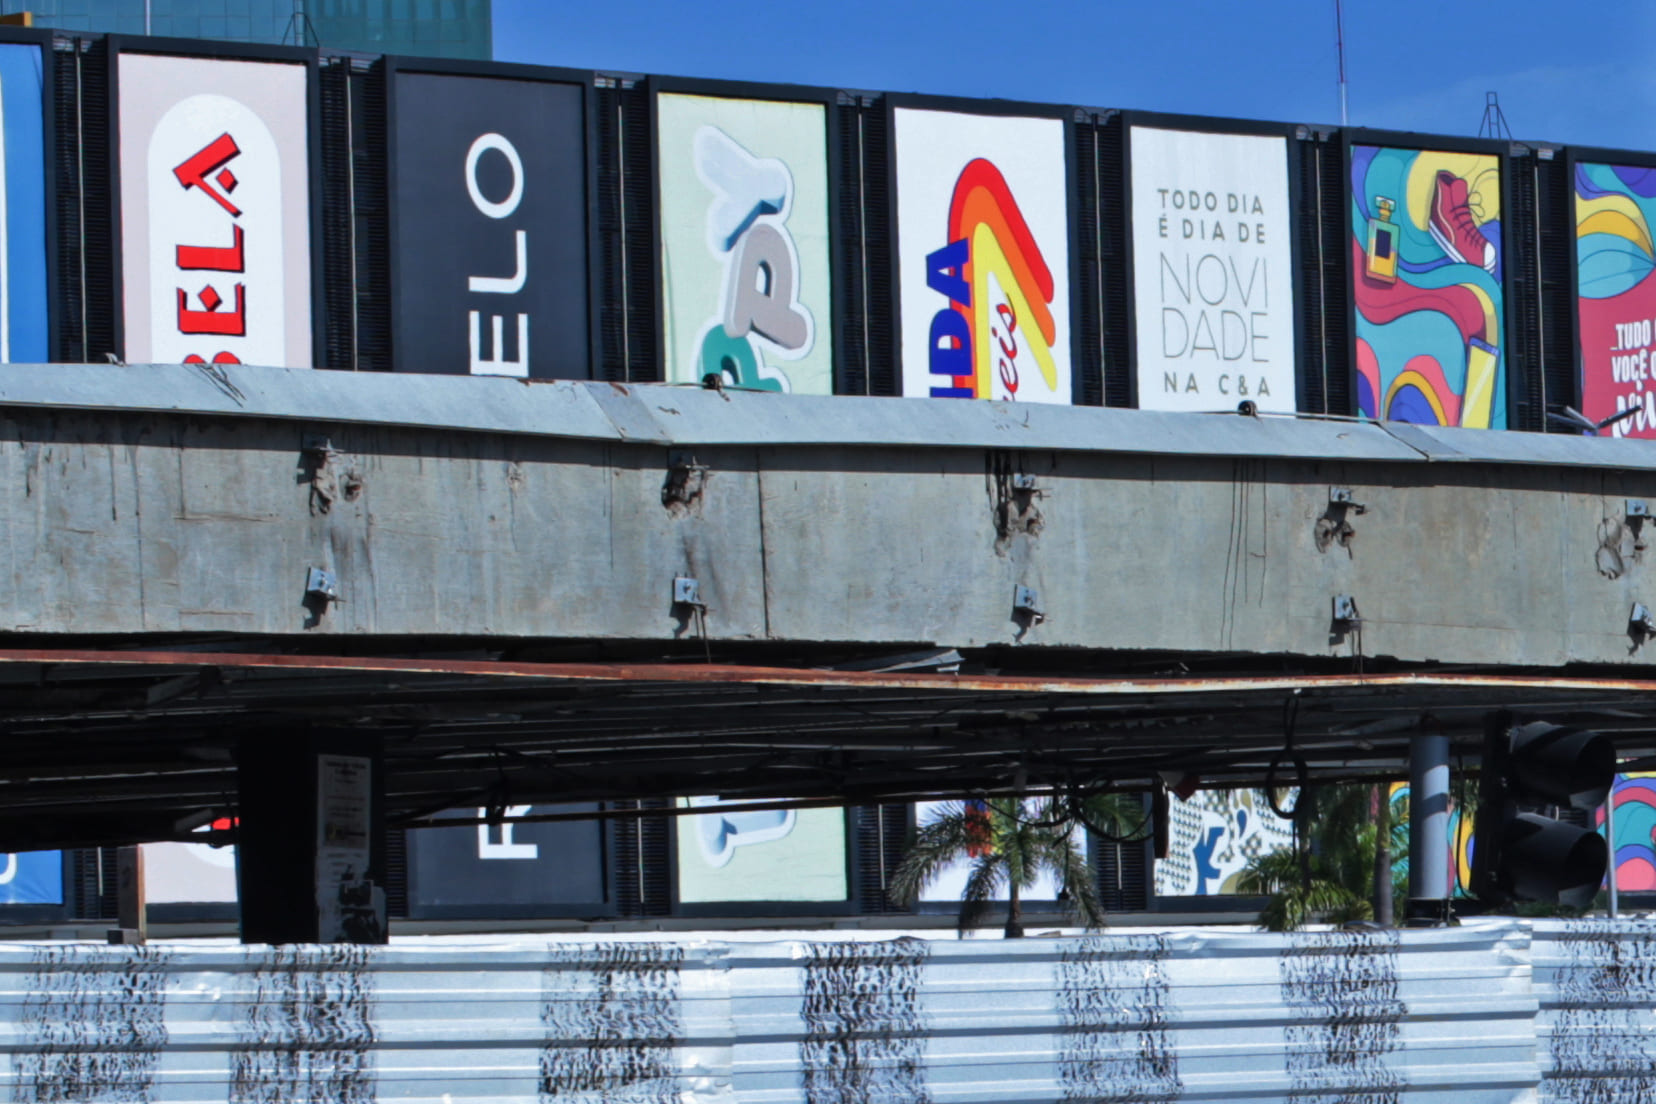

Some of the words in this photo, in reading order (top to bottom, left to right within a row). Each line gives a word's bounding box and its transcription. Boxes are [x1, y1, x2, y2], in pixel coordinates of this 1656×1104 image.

[1157, 189, 1218, 212] TODO
[1227, 193, 1264, 215] DIA
[1159, 213, 1169, 238] É
[1182, 219, 1225, 241] DIA
[1238, 222, 1265, 244] DE
[173, 132, 245, 364] ELA
[1160, 251, 1268, 308] NOVI
[1162, 307, 1269, 362] DADE
[1615, 319, 1653, 350] TUDO
[1611, 348, 1649, 383] VOCÊ
[1163, 371, 1199, 394] NA
[1218, 373, 1270, 397] C&A
